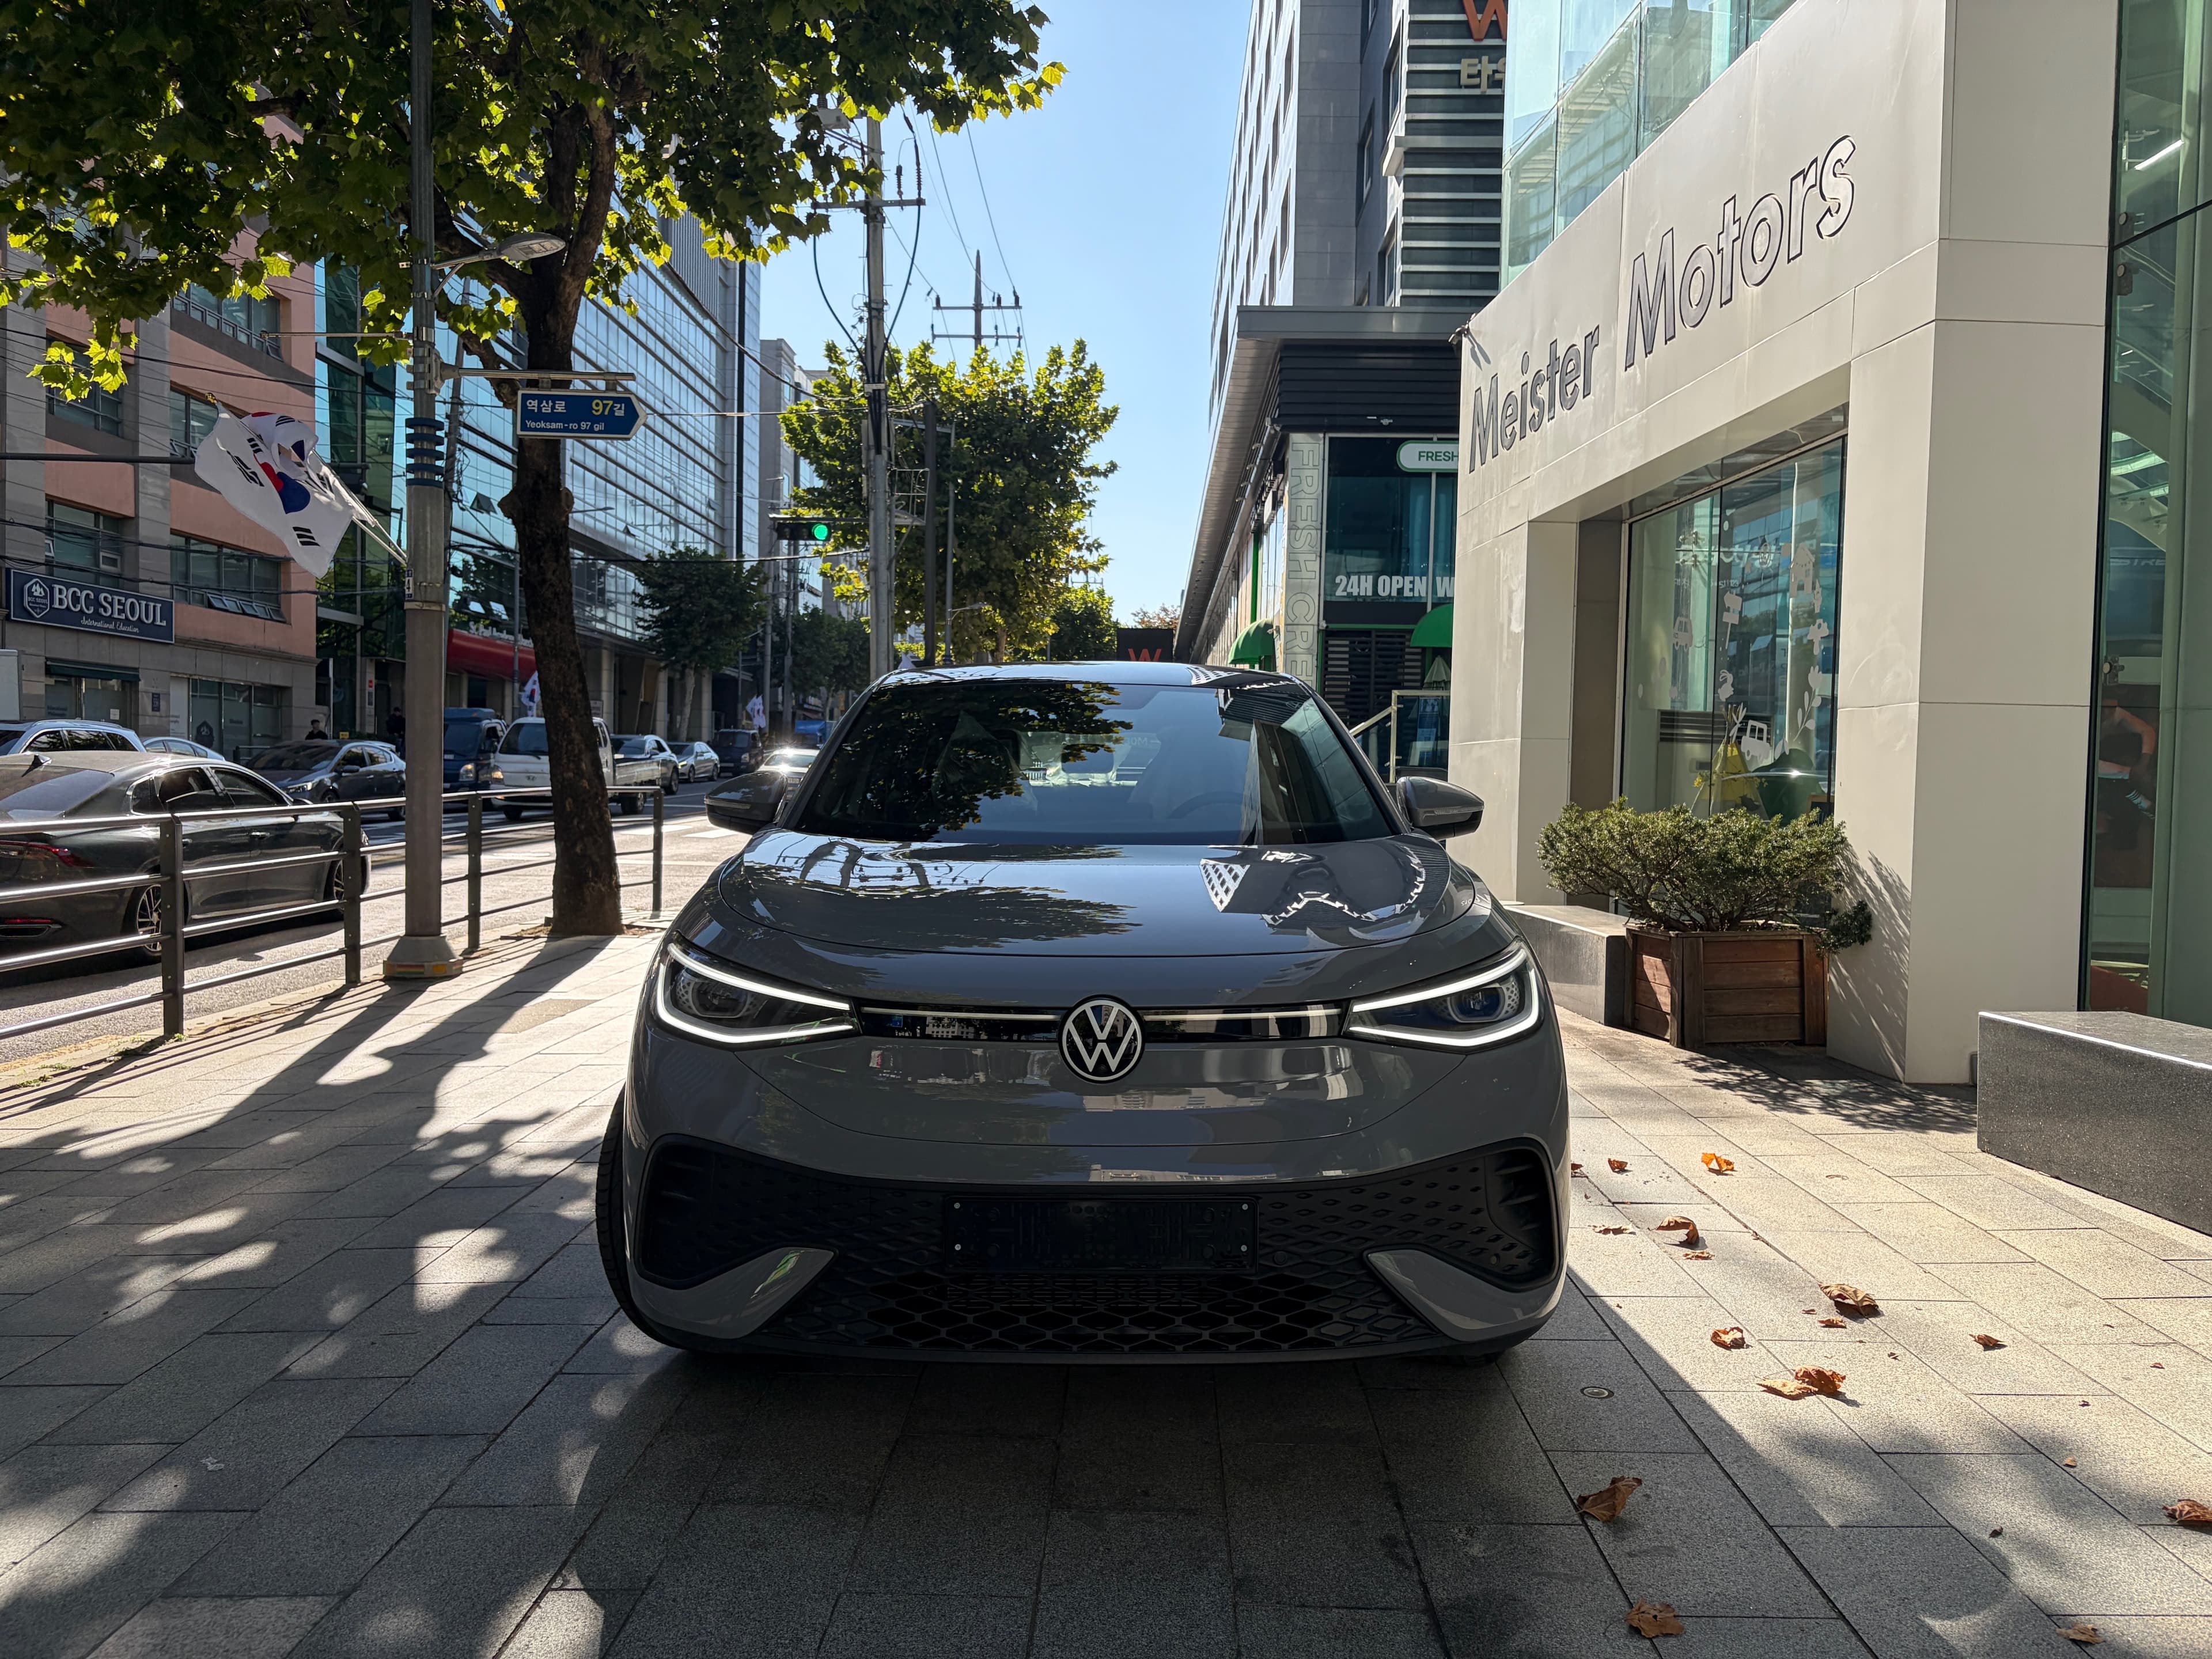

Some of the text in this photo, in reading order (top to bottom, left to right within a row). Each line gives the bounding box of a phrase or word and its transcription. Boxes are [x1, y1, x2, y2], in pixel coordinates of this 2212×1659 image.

[1469, 135, 1856, 474] Meister Motors
[526, 399, 625, 416] 역삼로 97길
[525, 420, 604, 431] Yeoksam-ro 97 gil
[1418, 451, 1459, 461] FRESH
[1285, 442, 1320, 687] FRESH CRE
[1335, 575, 1373, 597] 24H
[1377, 575, 1427, 597] OPEN
[52, 584, 166, 627] BCC SEOUL
[81, 615, 139, 633] International Education
